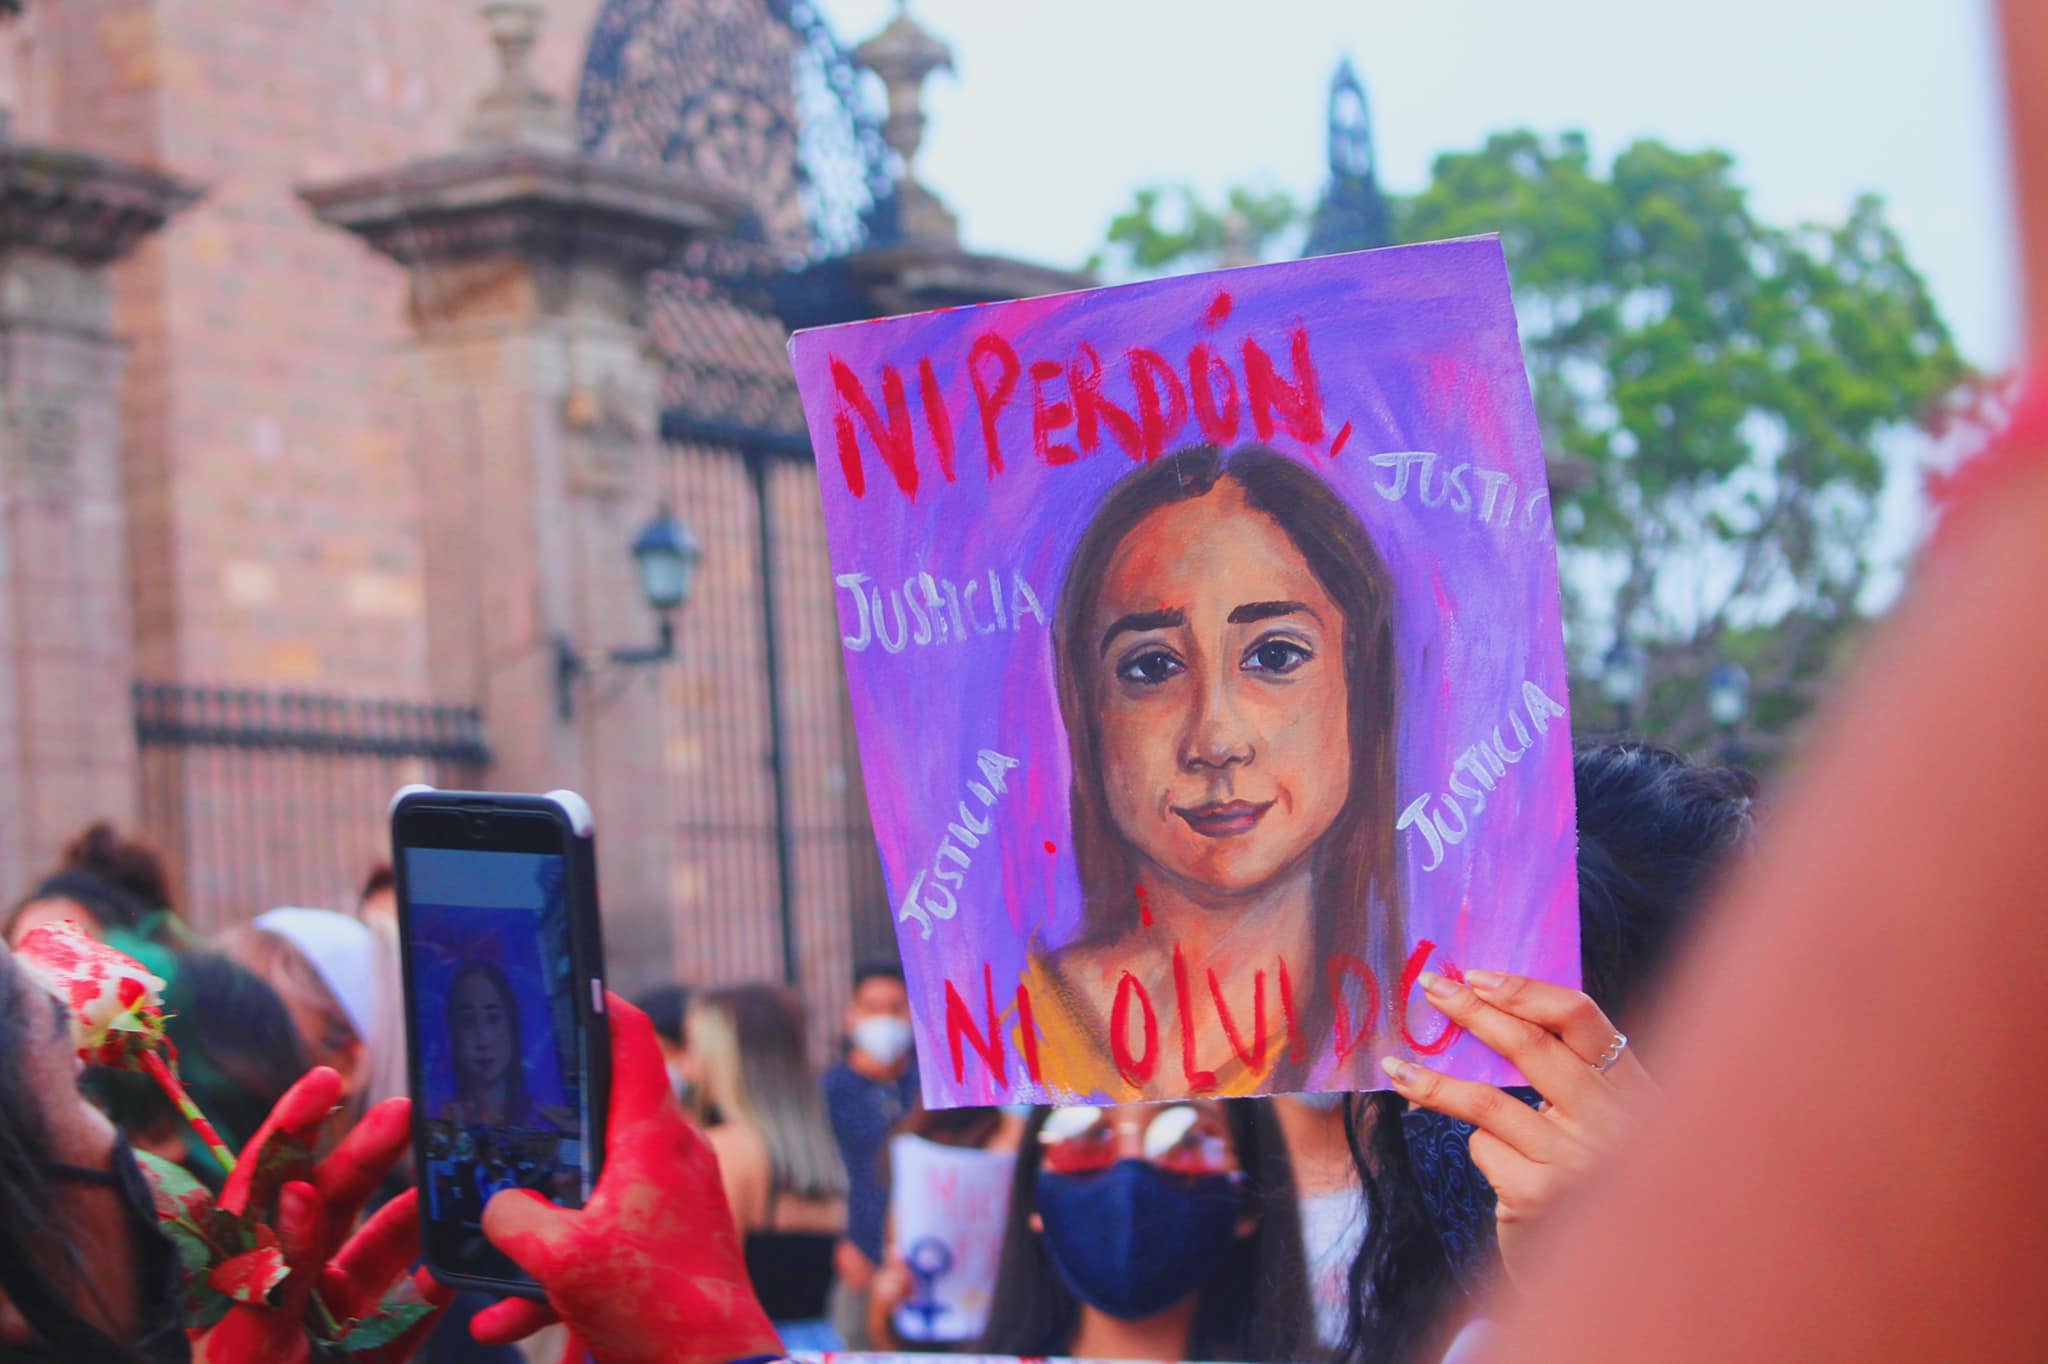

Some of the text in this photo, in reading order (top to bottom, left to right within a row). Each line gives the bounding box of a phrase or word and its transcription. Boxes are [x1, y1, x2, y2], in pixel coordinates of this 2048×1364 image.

[829, 288, 1352, 502] NI PERDÓN,
[836, 568, 1045, 654] JUSTICIA
[899, 747, 1020, 940] JUSTICIA
[1396, 680, 1566, 872] JUSTICIA
[944, 939, 1466, 1092] NI OLVIDO
